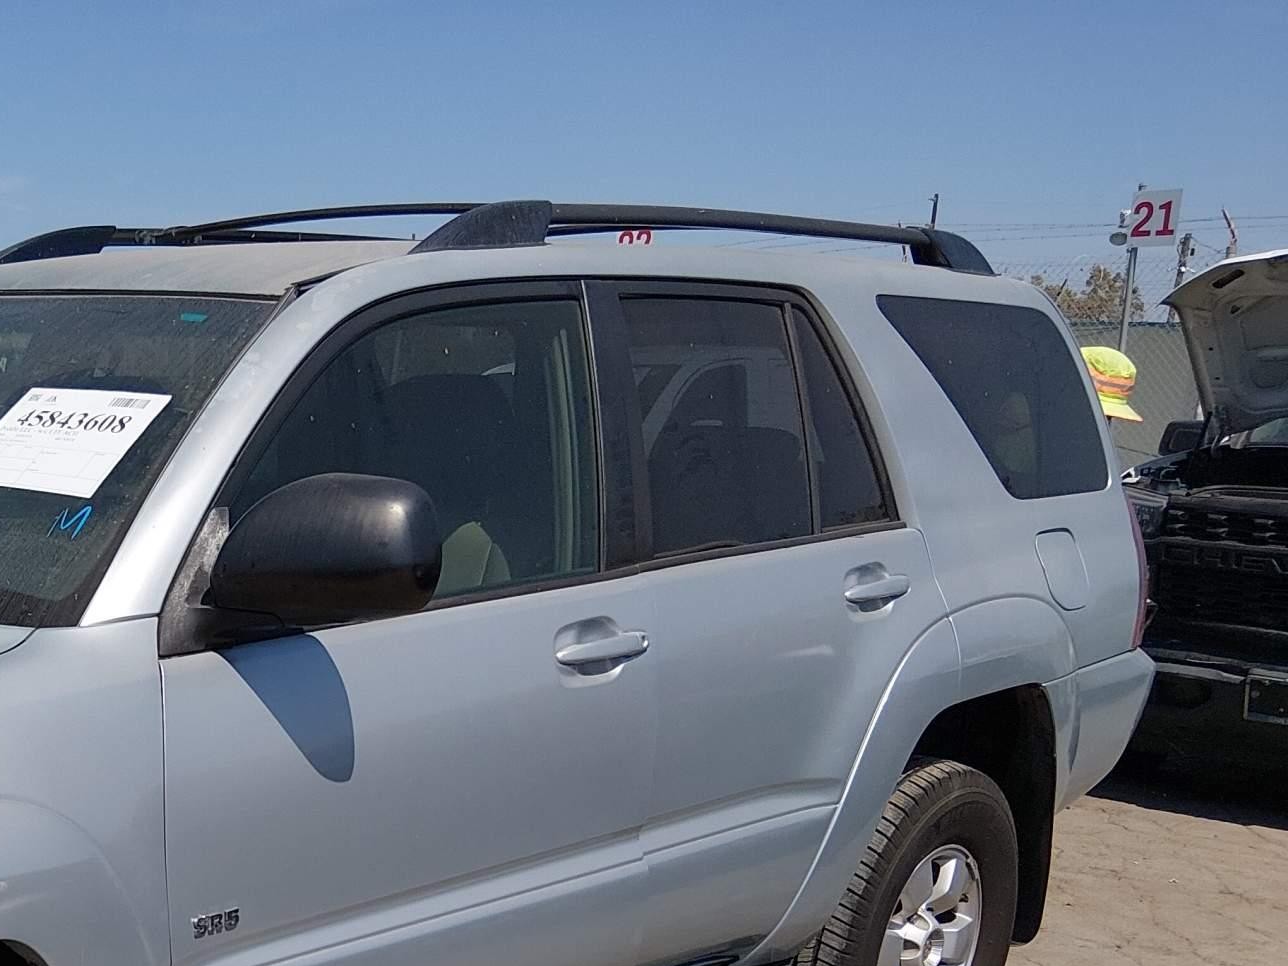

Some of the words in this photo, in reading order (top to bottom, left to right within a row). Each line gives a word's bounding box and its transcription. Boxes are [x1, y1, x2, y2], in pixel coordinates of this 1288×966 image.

[1130, 199, 1175, 238] 21
[16, 408, 133, 434] 45843608
[47, 504, 93, 541] M
[190, 906, 240, 940] SR5
